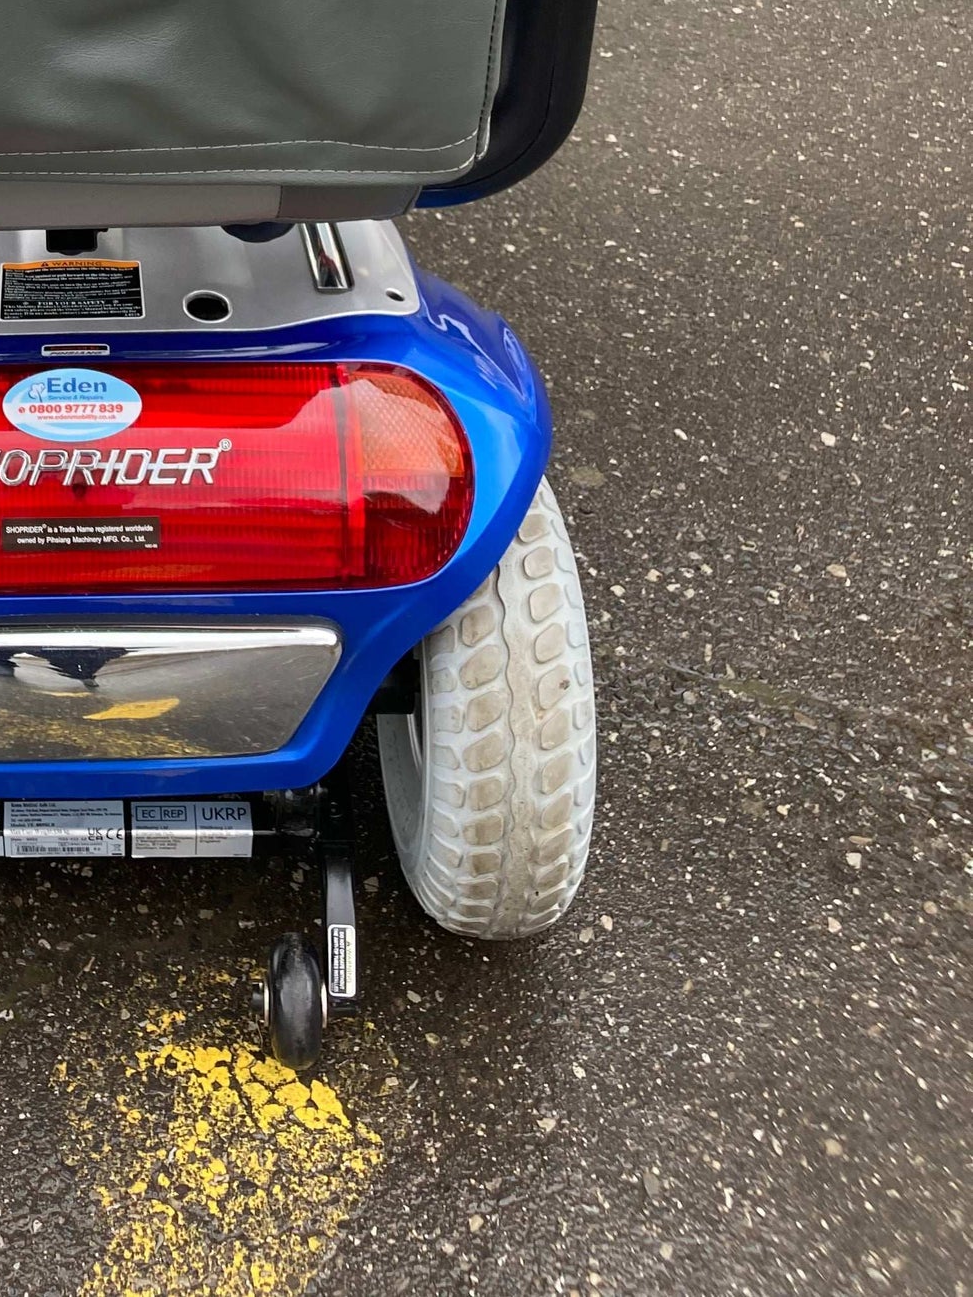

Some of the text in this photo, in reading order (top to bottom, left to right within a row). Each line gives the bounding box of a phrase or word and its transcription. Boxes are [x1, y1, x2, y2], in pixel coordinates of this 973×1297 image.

[47, 377, 107, 393] Eden
[29, 403, 124, 414] 0800 9777 839
[47, 525, 53, 533] is
[59, 525, 76, 533] Trade
[76, 525, 94, 533] Name
[95, 525, 123, 534] registered
[124, 525, 153, 533] worldwide
[16, 536, 36, 544] owned
[37, 536, 45, 545] by
[72, 536, 102, 545] Machinery
[141, 809, 184, 818] EC REP
[202, 807, 247, 821] UKRP
